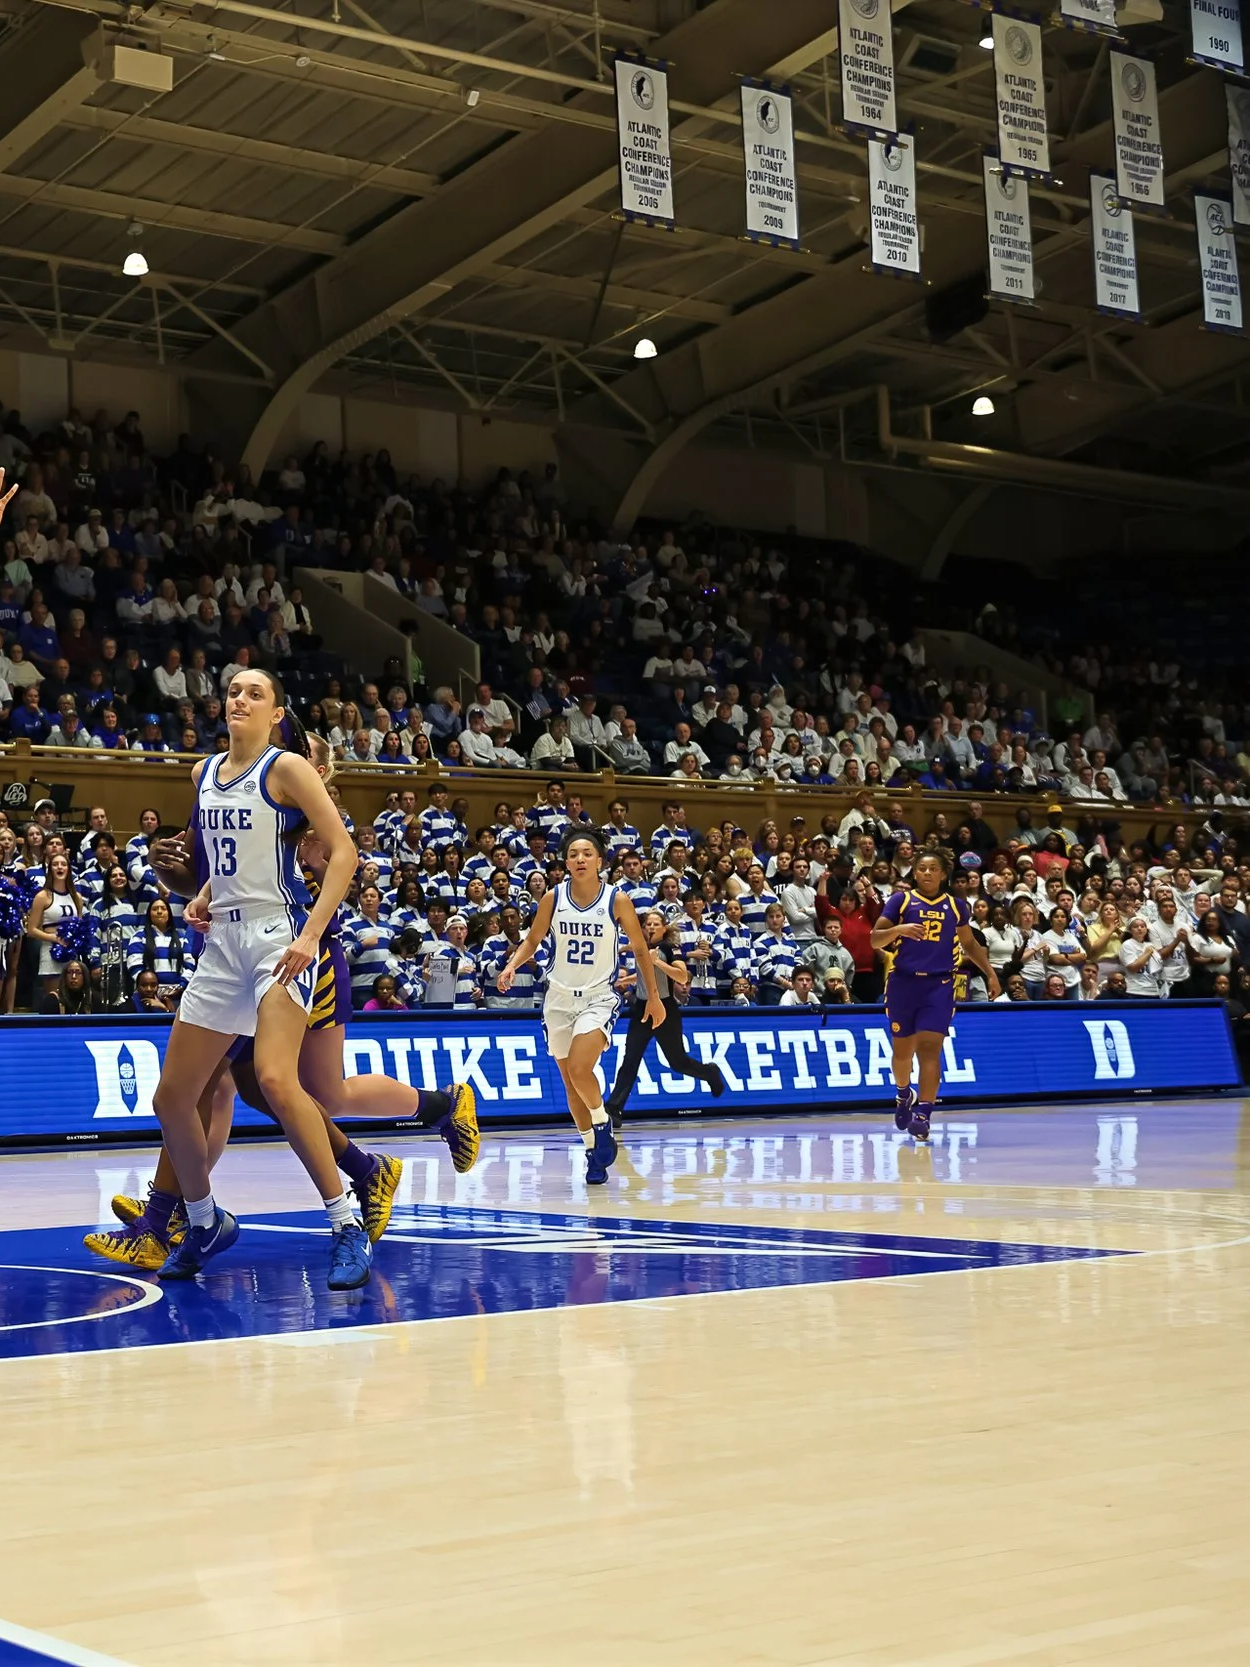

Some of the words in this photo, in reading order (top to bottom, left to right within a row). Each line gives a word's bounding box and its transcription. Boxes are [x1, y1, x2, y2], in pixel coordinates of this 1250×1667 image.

[850, 28, 883, 47] ATLANTIC
[1209, 36, 1229, 52] 1990
[855, 44, 879, 59] COAST
[844, 55, 892, 78] CONFERENCE
[847, 70, 891, 92] CHAMPIONS
[1005, 74, 1036, 91] ATLANTIC
[1011, 89, 1033, 103] COAST
[861, 106, 881, 120] 1964
[1000, 101, 1045, 120] CONFERENCE
[1122, 110, 1152, 126] ATLANTIC
[628, 121, 661, 139] ATLANTIC
[1003, 115, 1044, 133] CHAMPIONS
[1127, 125, 1147, 138] COAST
[634, 136, 657, 151] COAST
[1117, 135, 1161, 154] CONFERENCE
[623, 147, 670, 167] CONFERENCE
[753, 144, 786, 160] ATLANTIC
[1018, 147, 1036, 161] 1965
[1120, 150, 1159, 167] CHAMPIONS
[625, 162, 669, 181] CHAMPIONS
[760, 159, 782, 173] COAST
[747, 170, 794, 189] CONFERENCE
[750, 184, 792, 202] CHAMPIONS
[878, 181, 908, 197] ATLANTIC
[639, 195, 658, 209] 2006
[884, 195, 905, 208] COAST
[764, 215, 783, 229] 2009
[872, 205, 915, 224] CONFERENCE
[994, 211, 1023, 225] ATLANTIC
[875, 219, 915, 237] CHAMPIONS
[1000, 224, 1019, 236] COAST
[1102, 228, 1128, 242] ATLANTIC
[990, 235, 1030, 251] CONFERENCE
[1106, 241, 1124, 254] COAST
[887, 249, 906, 262] 2010
[993, 248, 1030, 263] CHAMPIONS
[1097, 251, 1134, 267] CONFERENCE
[1100, 264, 1134, 279] CHAMPIONS
[1006, 277, 1022, 289] 2011
[200, 808, 253, 831] DUKE
[213, 837, 238, 877] 13
[919, 909, 945, 920] LSU
[559, 922, 604, 937] DUKE
[567, 939, 595, 965] 22
[343, 1036, 544, 1101] DUKE
